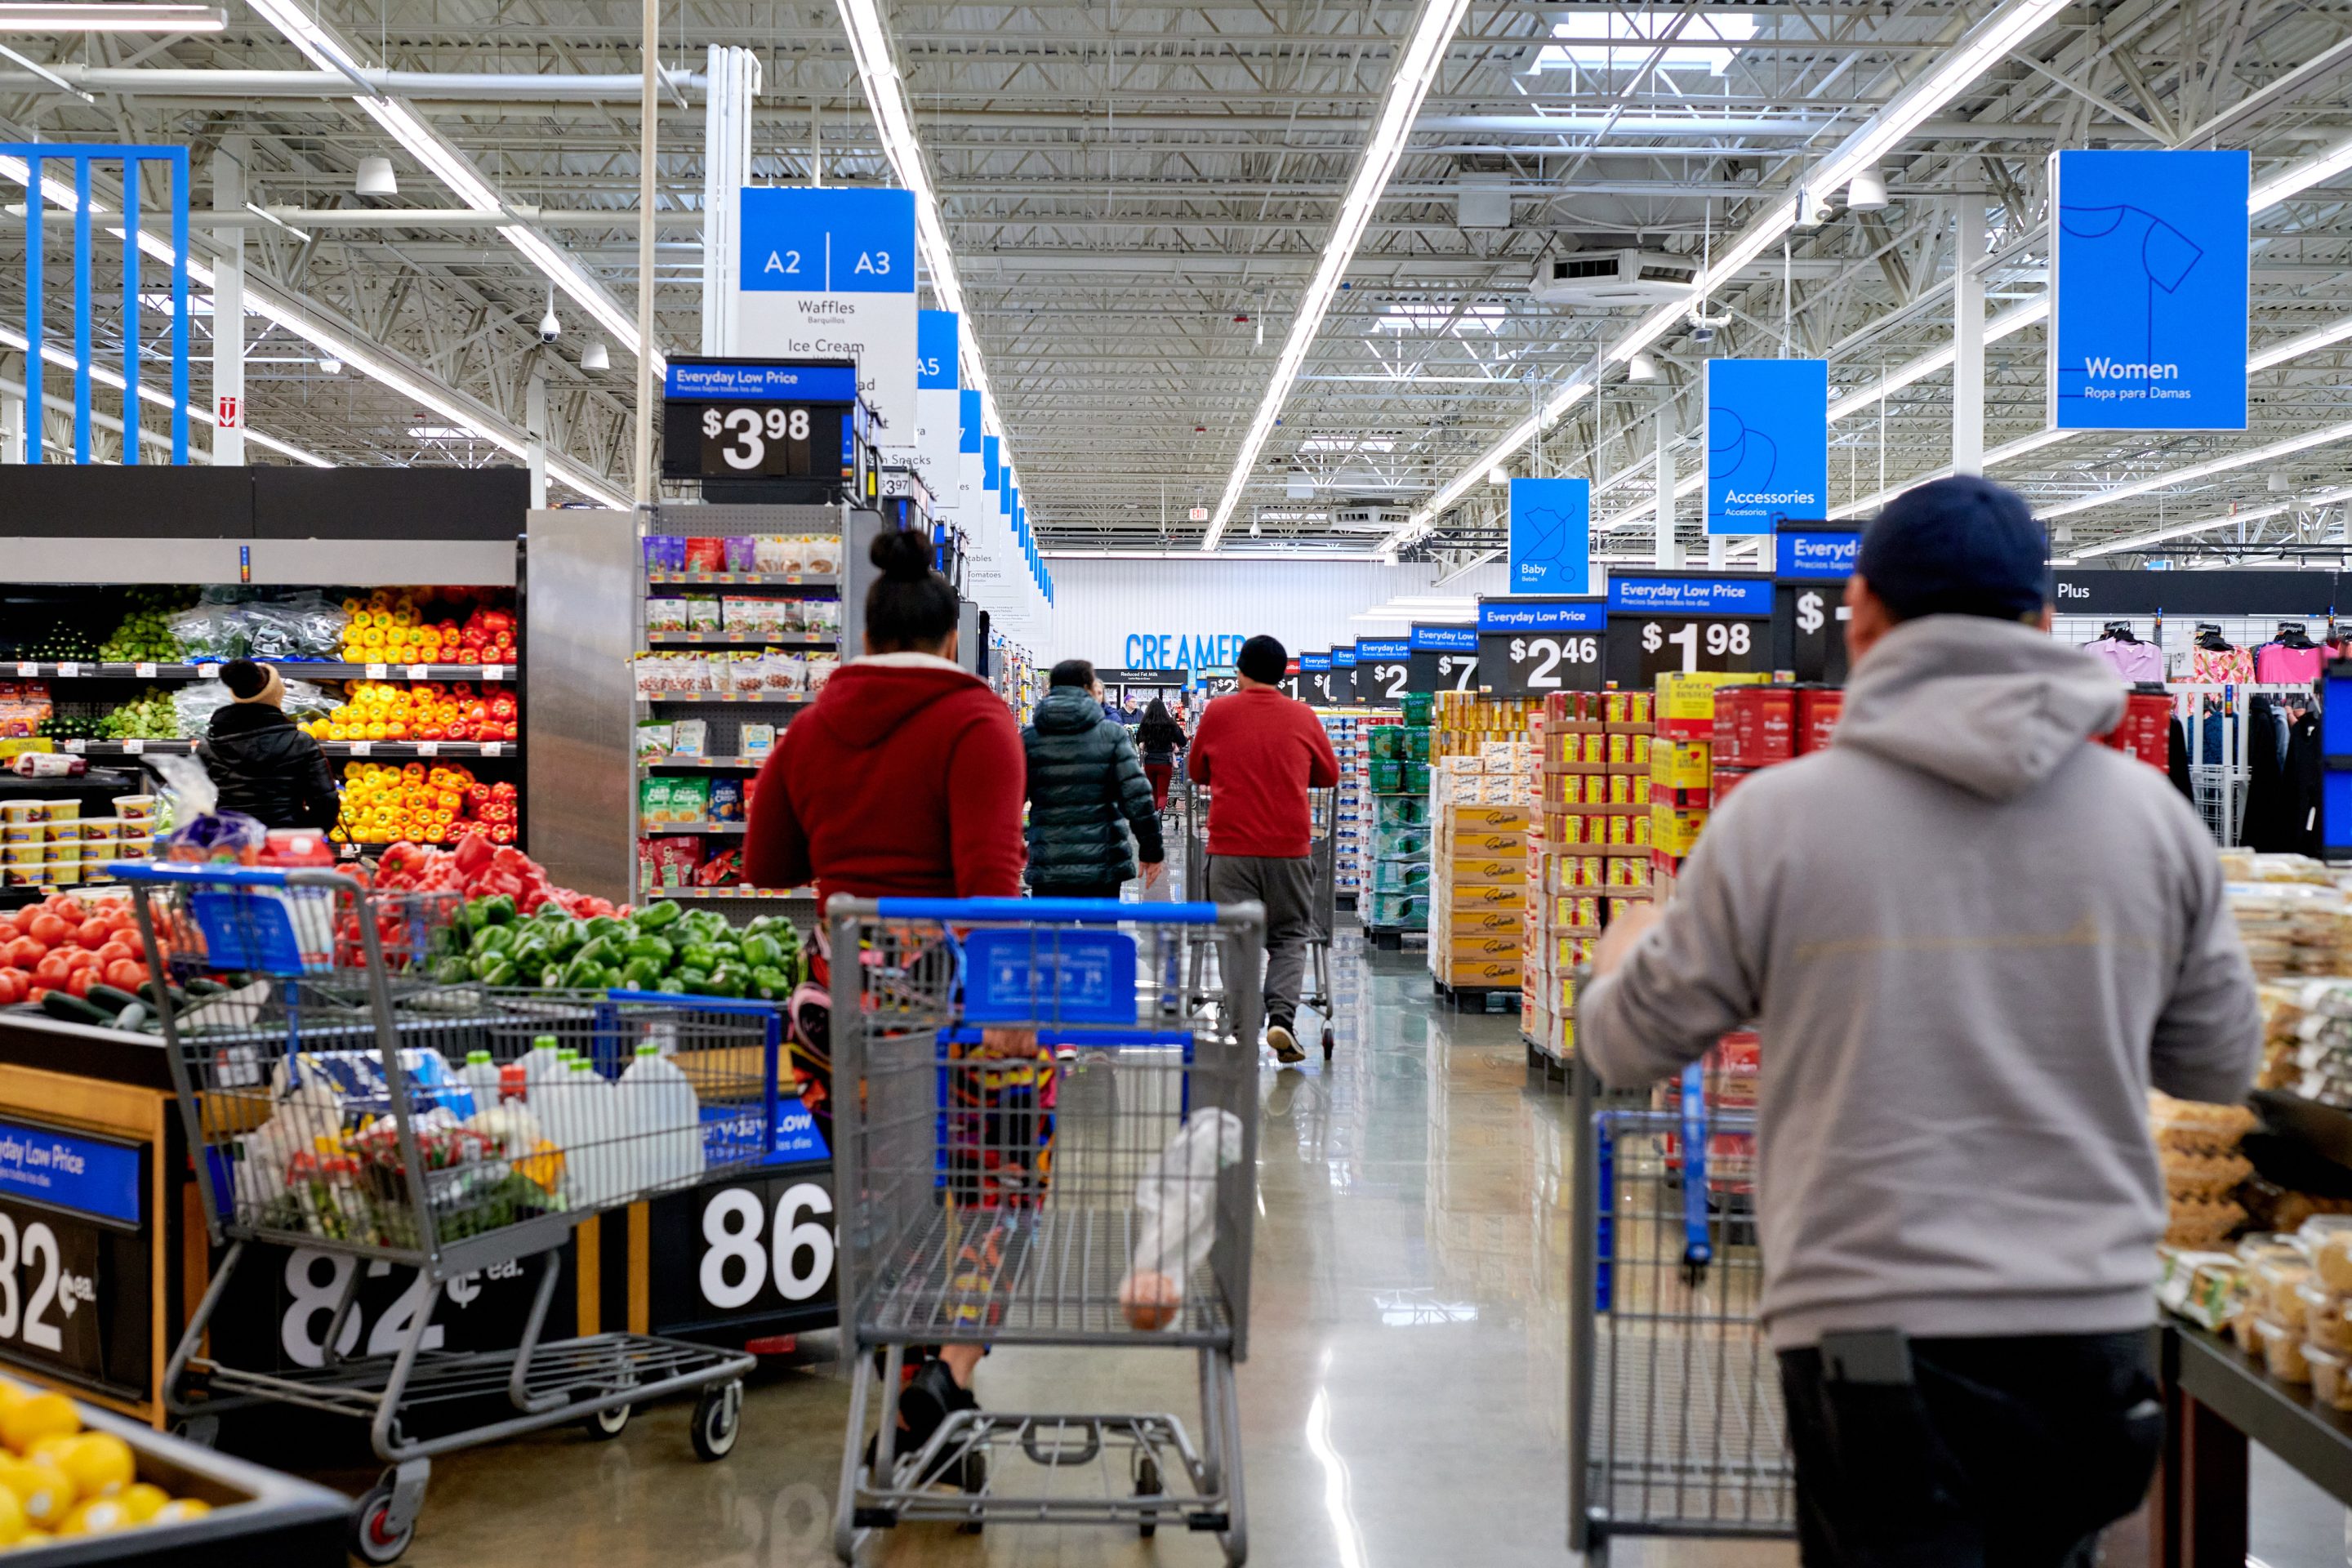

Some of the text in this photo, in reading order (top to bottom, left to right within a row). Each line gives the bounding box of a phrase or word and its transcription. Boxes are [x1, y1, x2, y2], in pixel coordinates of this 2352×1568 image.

[764, 250, 800, 274] A2
[854, 251, 890, 275] A3
[798, 300, 855, 314] Waffles
[808, 316, 845, 325] Barquillos
[789, 338, 865, 352] Ice Cream
[917, 358, 939, 376] A5
[2085, 357, 2179, 380] Women
[677, 369, 798, 386] Everyday Low Price
[2085, 386, 2191, 401] Ropa para Damas
[892, 455, 931, 465] Snacks
[1725, 489, 1815, 504] Accessories
[1192, 509, 1205, 519] EXIT
[1725, 508, 1767, 516] Accesorios
[1521, 564, 1547, 577] Baby
[1621, 582, 1746, 599] Everyday Low Price
[2057, 583, 2090, 599] Plus
[1487, 611, 1586, 624] Everyday Low Price
[1419, 630, 1475, 641] Everyday Low
[1339, 651, 1356, 661] Every
[1362, 644, 1393, 654] Everyday
[776, 1113, 813, 1134] ow
[26, 1139, 51, 1167] Low
[52, 1143, 86, 1174] Price
[699, 1182, 840, 1309] 86
